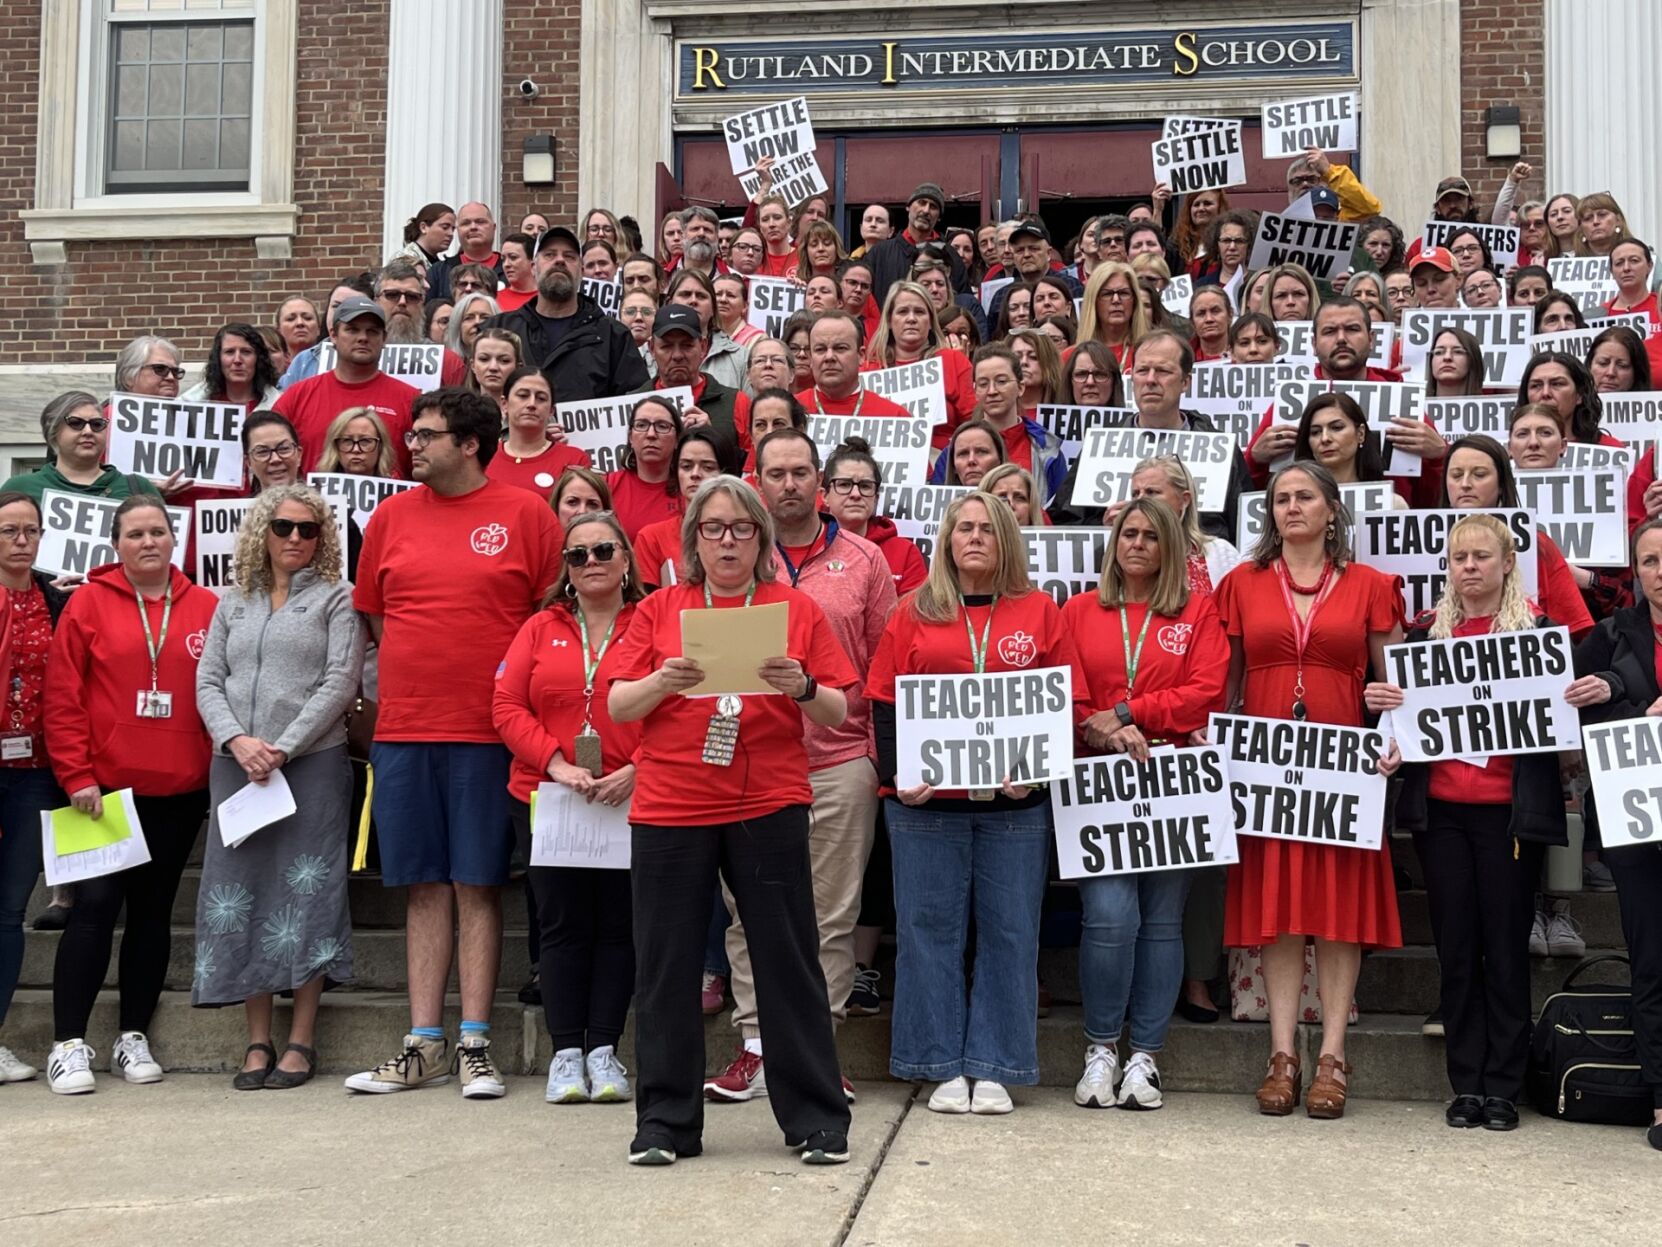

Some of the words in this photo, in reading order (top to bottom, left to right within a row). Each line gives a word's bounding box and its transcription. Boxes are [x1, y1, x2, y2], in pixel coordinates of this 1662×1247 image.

[692, 48, 873, 88] RUTLAND
[881, 42, 1161, 84] INTERMEDIATE
[1174, 32, 1340, 75] SCHOOL
[726, 100, 807, 143] SETTLE
[1267, 96, 1351, 129] SETTLE
[743, 130, 799, 167] NOW
[1155, 128, 1240, 166] SETTLE
[1282, 125, 1339, 153] NOW
[788, 152, 814, 174] THE
[1170, 160, 1229, 193] NOW
[771, 172, 818, 206] ION
[1261, 215, 1356, 251] SETTLE
[754, 284, 804, 312] SET
[117, 399, 240, 442] SETTLE
[562, 406, 612, 434] DON'T
[1238, 400, 1252, 411] ON
[132, 440, 220, 480] NOW
[1089, 430, 1229, 463] TEACHERS
[1389, 630, 1566, 690] TEACHERS
[900, 671, 1066, 719] TEACHERS
[1472, 685, 1492, 701] ON
[975, 721, 994, 735] ON
[1417, 697, 1557, 757] STRIKE
[920, 733, 1050, 787] STRIKE
[1213, 717, 1384, 775] TEACHERS
[1589, 721, 1662, 772] TEA
[1060, 750, 1223, 806] TEACHERS
[1284, 769, 1303, 785] ON
[1132, 802, 1152, 818] ON
[1230, 781, 1360, 842] STRIKE
[1079, 815, 1216, 873] STRIKE
